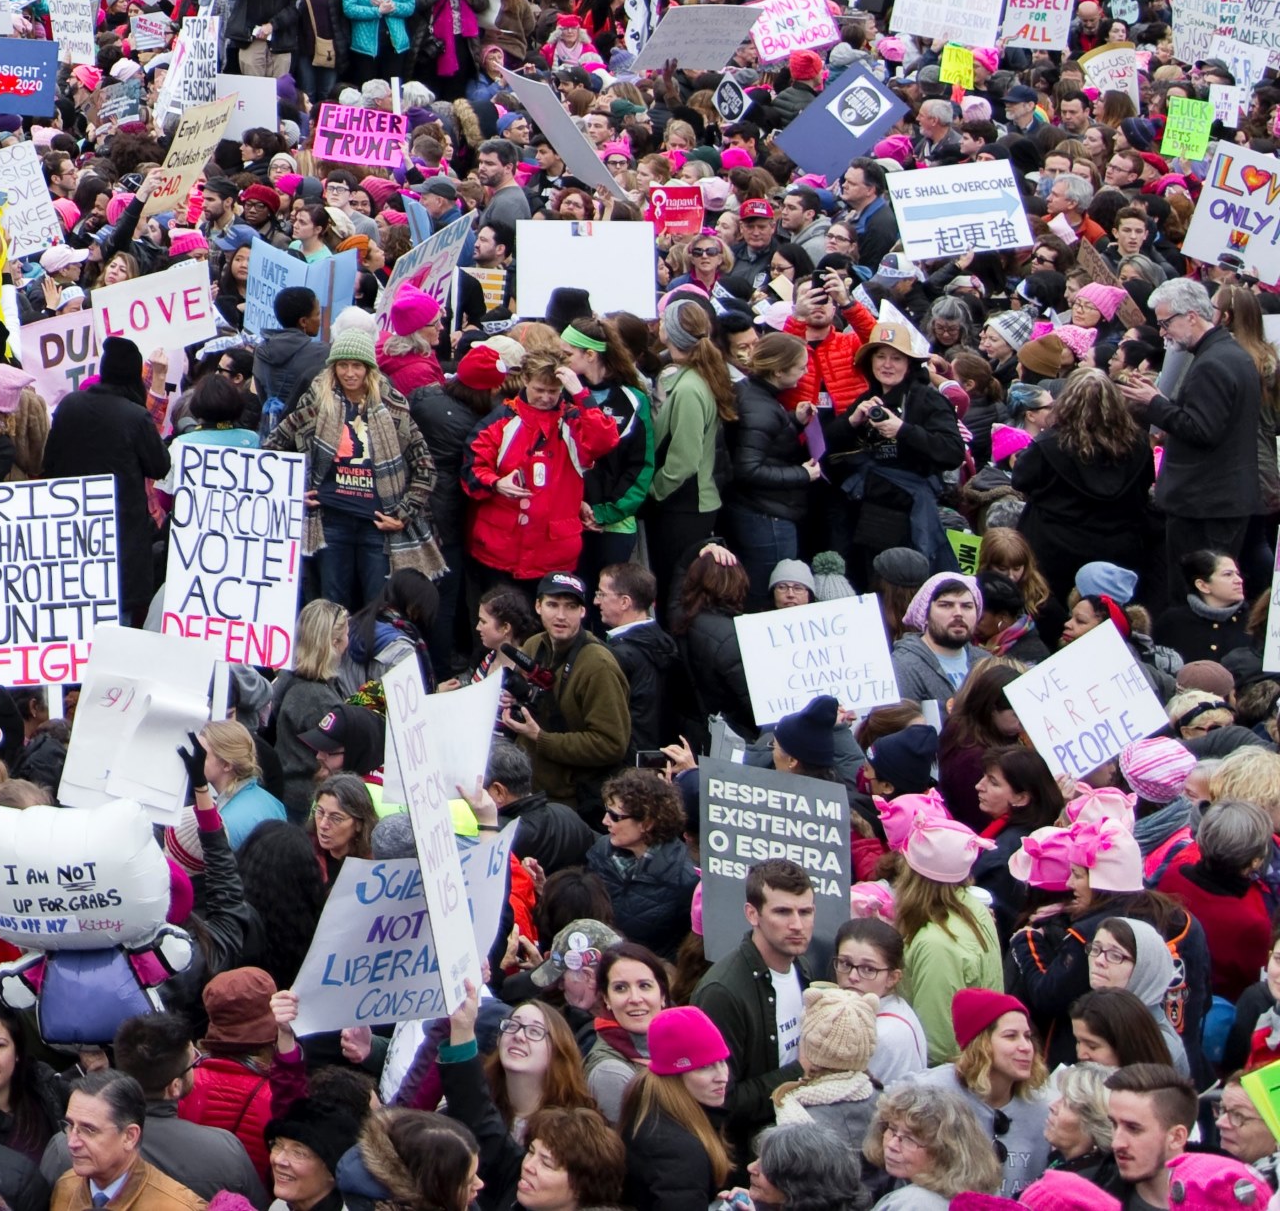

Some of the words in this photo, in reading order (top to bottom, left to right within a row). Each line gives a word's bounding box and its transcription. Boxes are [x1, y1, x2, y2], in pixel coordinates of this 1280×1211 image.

[1016, 24, 1051, 42] ALL
[1030, 12, 1046, 21] FOR
[15, 79, 42, 91] 2020
[319, 130, 400, 160] TRUMP
[891, 188, 911, 199] WE
[916, 185, 948, 198] SHALL
[952, 178, 1015, 192] OVERCOME
[907, 218, 1018, 254] 一起更強
[104, 286, 205, 338] LOVE
[181, 445, 303, 496] RESIST
[335, 473, 374, 488] MARCH
[336, 465, 372, 477] WOMEN'S
[172, 486, 303, 540] OVERCOME
[172, 529, 297, 582] VOTE!
[179, 575, 273, 622] ACT
[767, 613, 848, 648] LYING
[788, 660, 873, 690] CHANGE
[1026, 668, 1069, 703] WE
[767, 696, 800, 714] THE
[806, 679, 896, 709] TRUTH
[1046, 686, 1110, 741] ARE
[1112, 666, 1149, 697] THE
[1054, 710, 1142, 774] PEOPLE
[709, 779, 811, 815] RESPETA
[816, 799, 841, 820] MI
[709, 804, 842, 845] EXISTENCIA
[709, 830, 729, 852] O
[736, 835, 842, 874] ESPERA
[4, 865, 19, 885] I
[27, 869, 49, 884] AM
[58, 862, 96, 885] NOT
[13, 899, 32, 913] UP
[39, 898, 67, 912] FOR
[69, 889, 122, 911] GRABS
[22, 919, 40, 932] OFF
[46, 918, 68, 932] MY
[79, 919, 124, 935] Kitty
